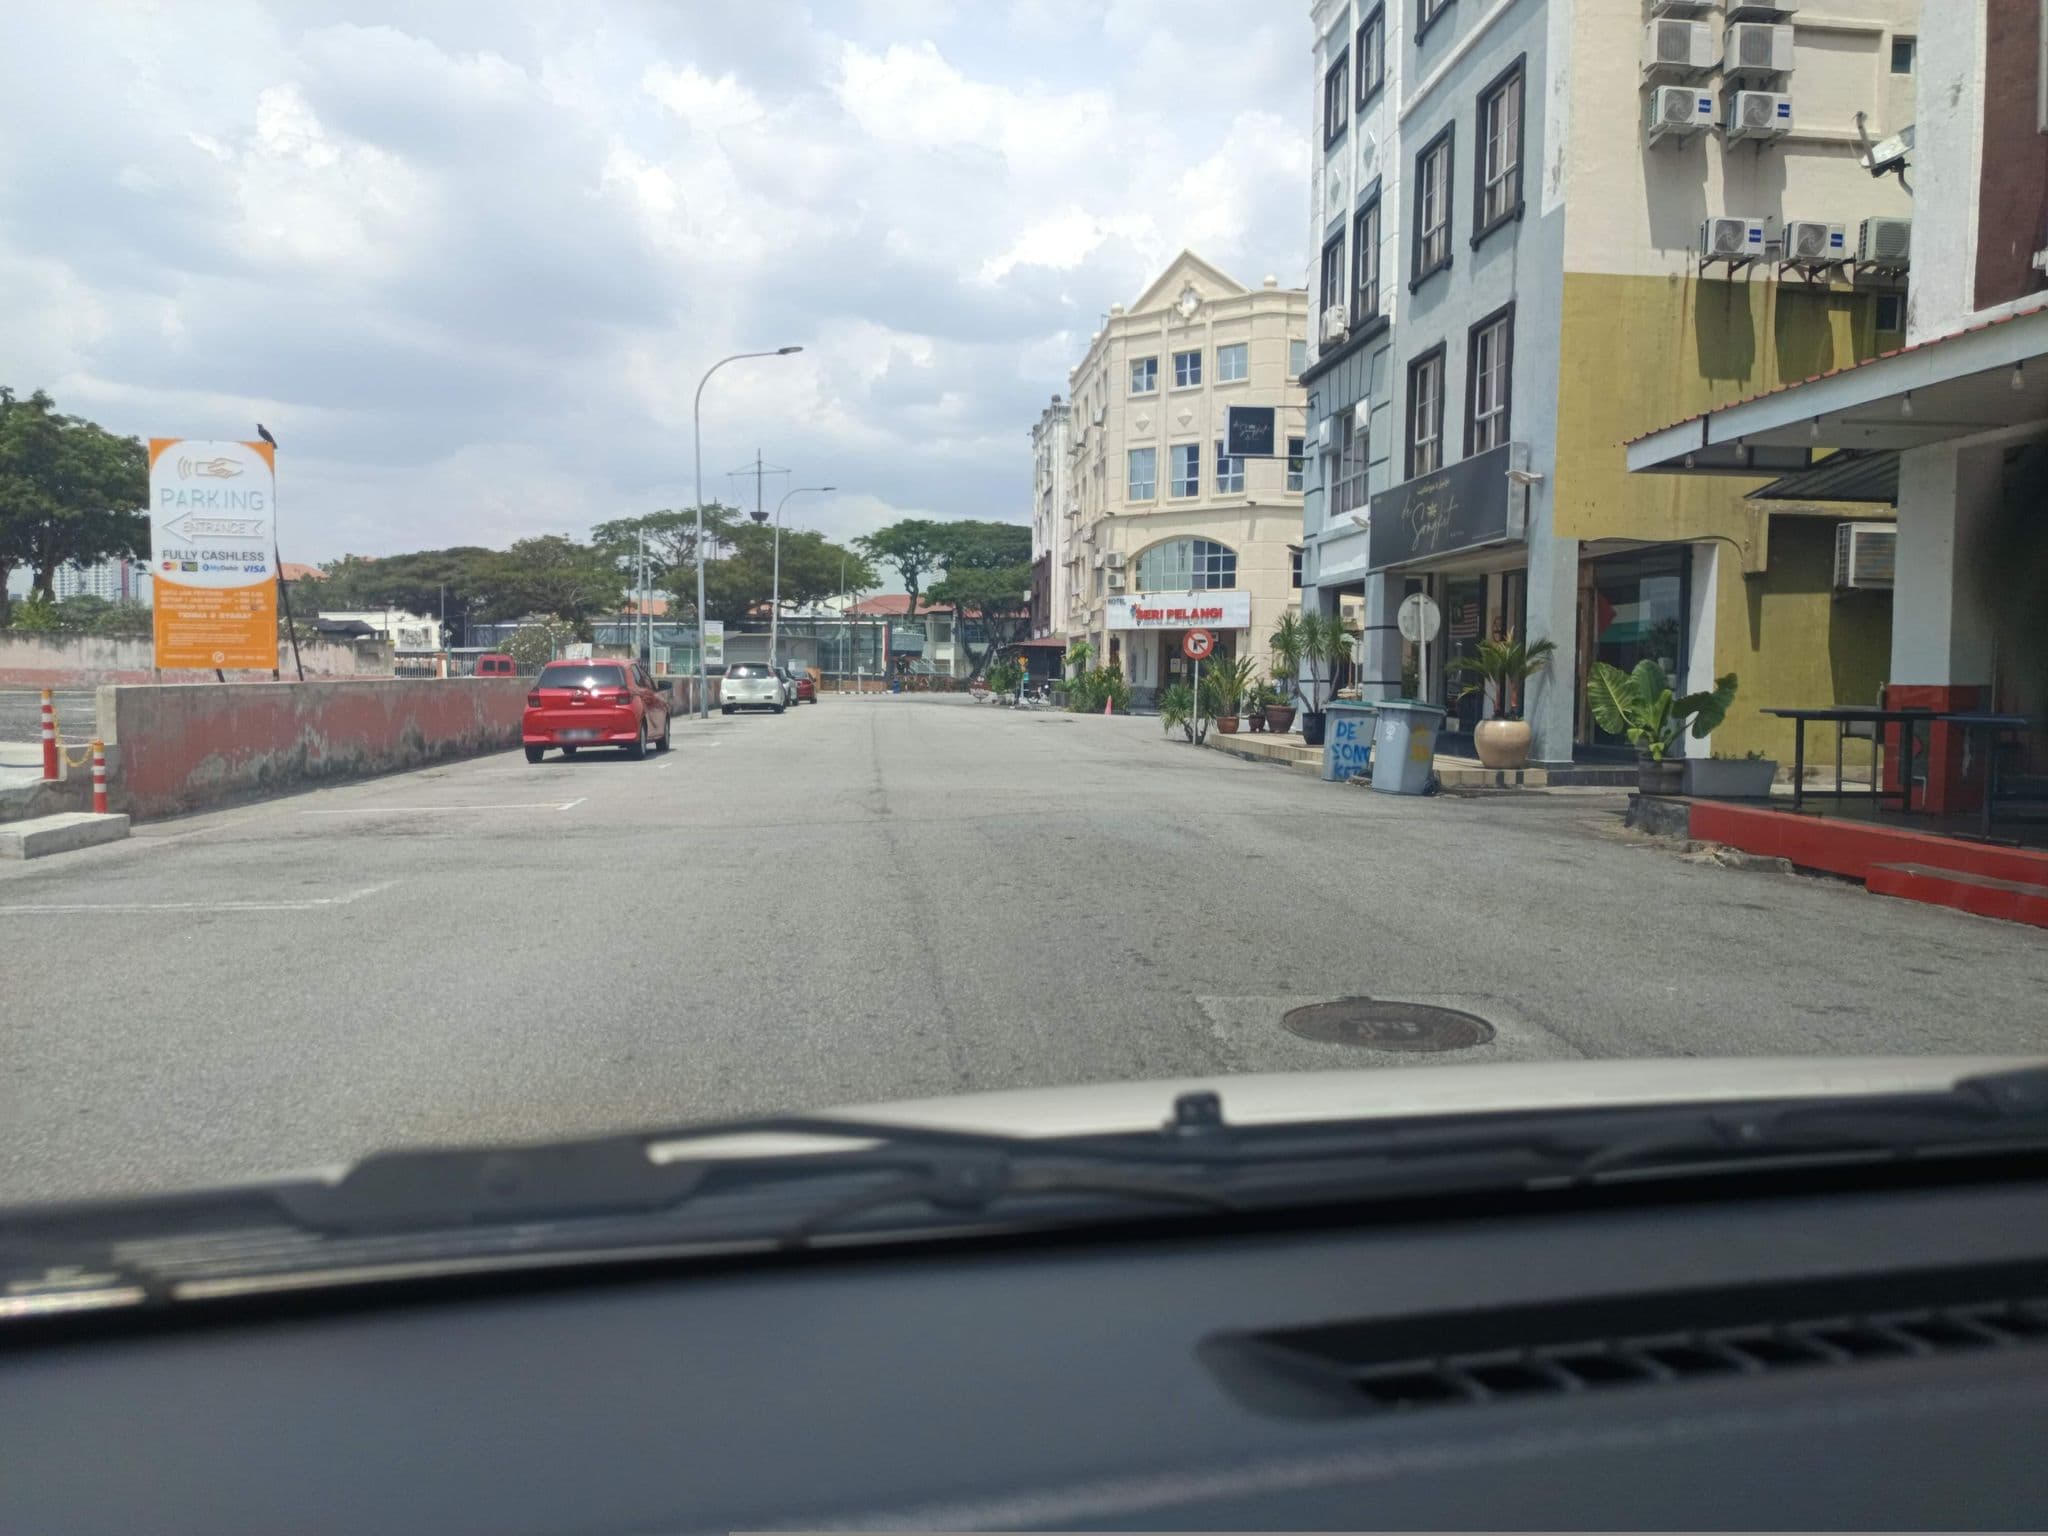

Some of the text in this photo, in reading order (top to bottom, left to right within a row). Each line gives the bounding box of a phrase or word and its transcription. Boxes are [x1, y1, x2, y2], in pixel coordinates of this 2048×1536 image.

[160, 488, 264, 511] PARKING
[183, 521, 246, 535] ENTRANCE
[162, 550, 265, 562] FULLY CASHLESS
[244, 565, 266, 573] VISA
[1166, 608, 1223, 619] PELANGI
